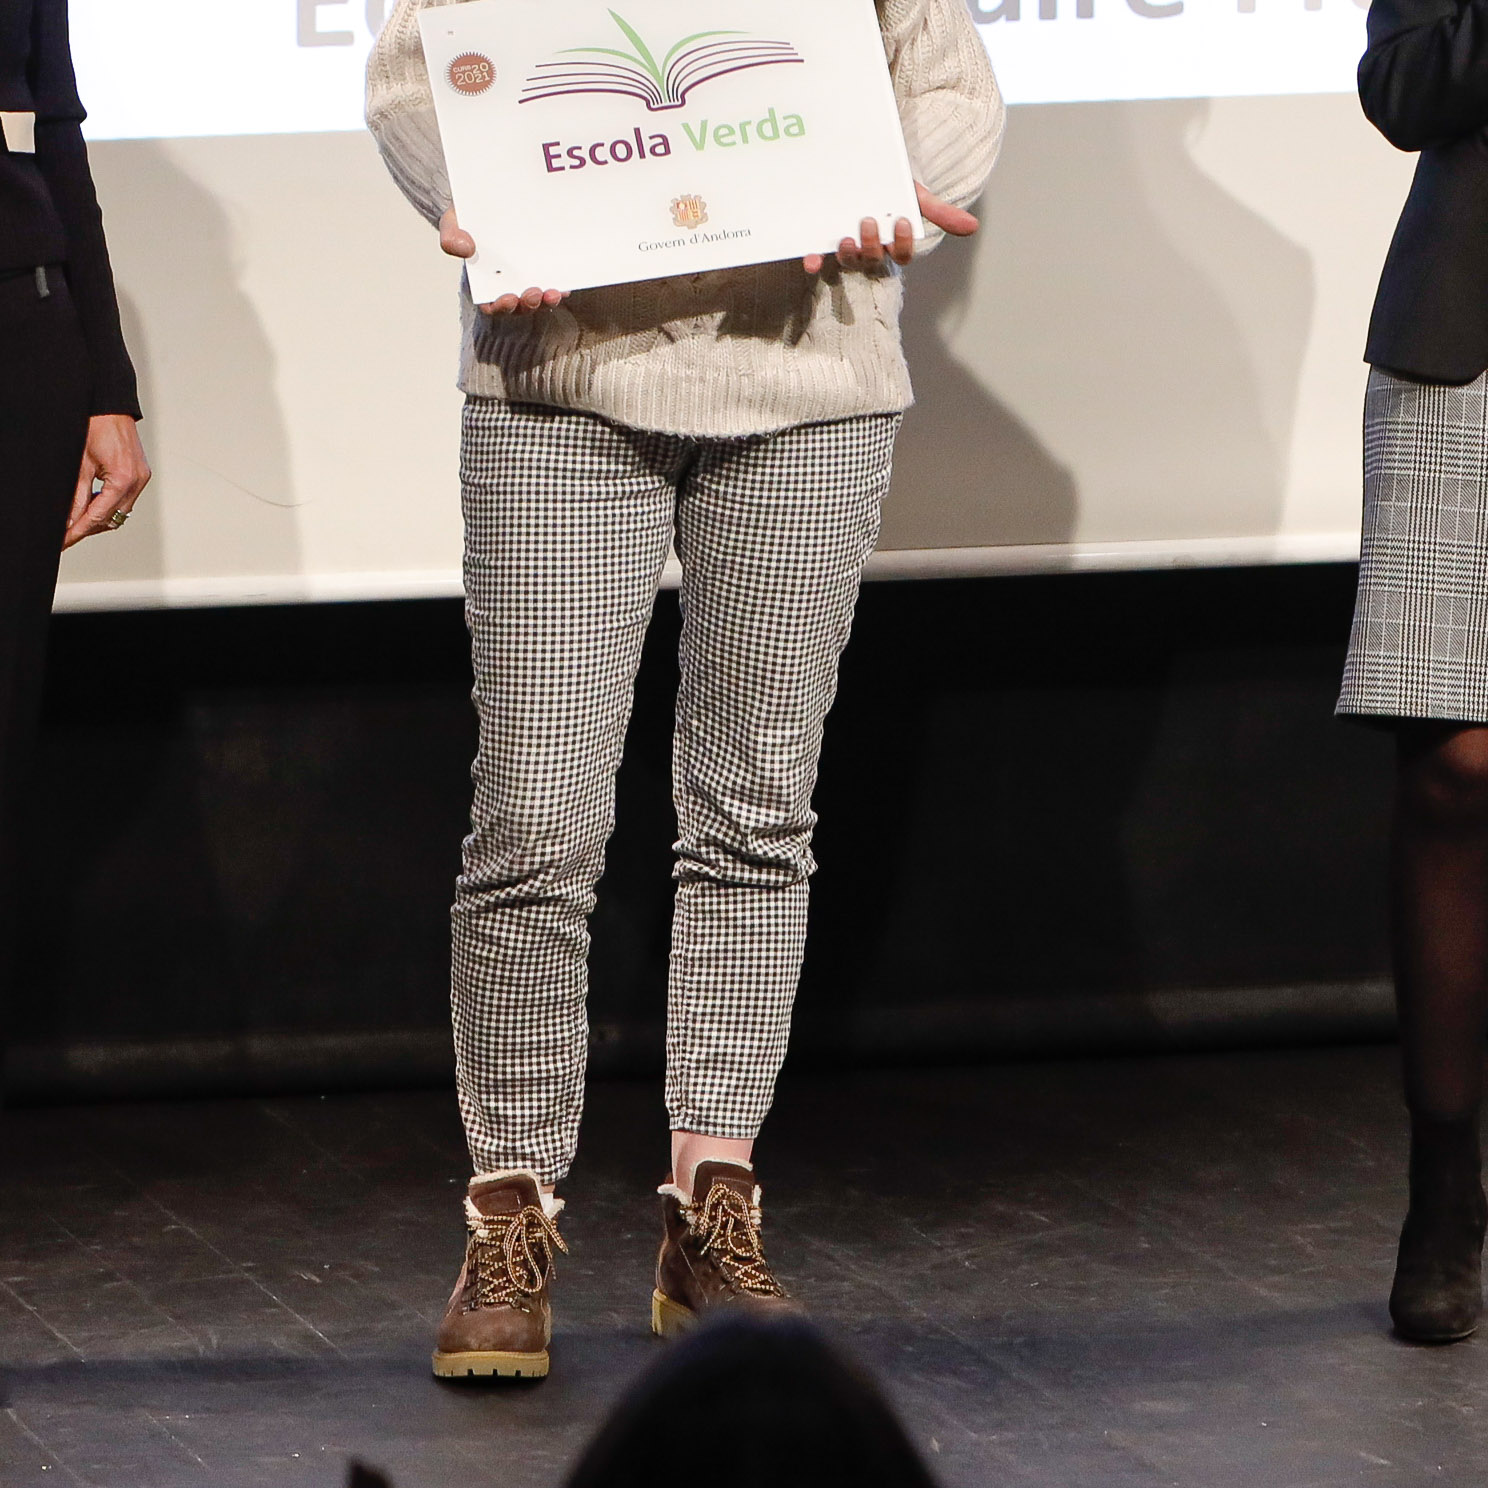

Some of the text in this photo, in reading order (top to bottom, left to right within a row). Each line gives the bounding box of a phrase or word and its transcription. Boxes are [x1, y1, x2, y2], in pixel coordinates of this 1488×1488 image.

[455, 71, 491, 86] 2021
[542, 107, 806, 173] Escola Verda
[638, 229, 752, 252] Govern d'Andorra
